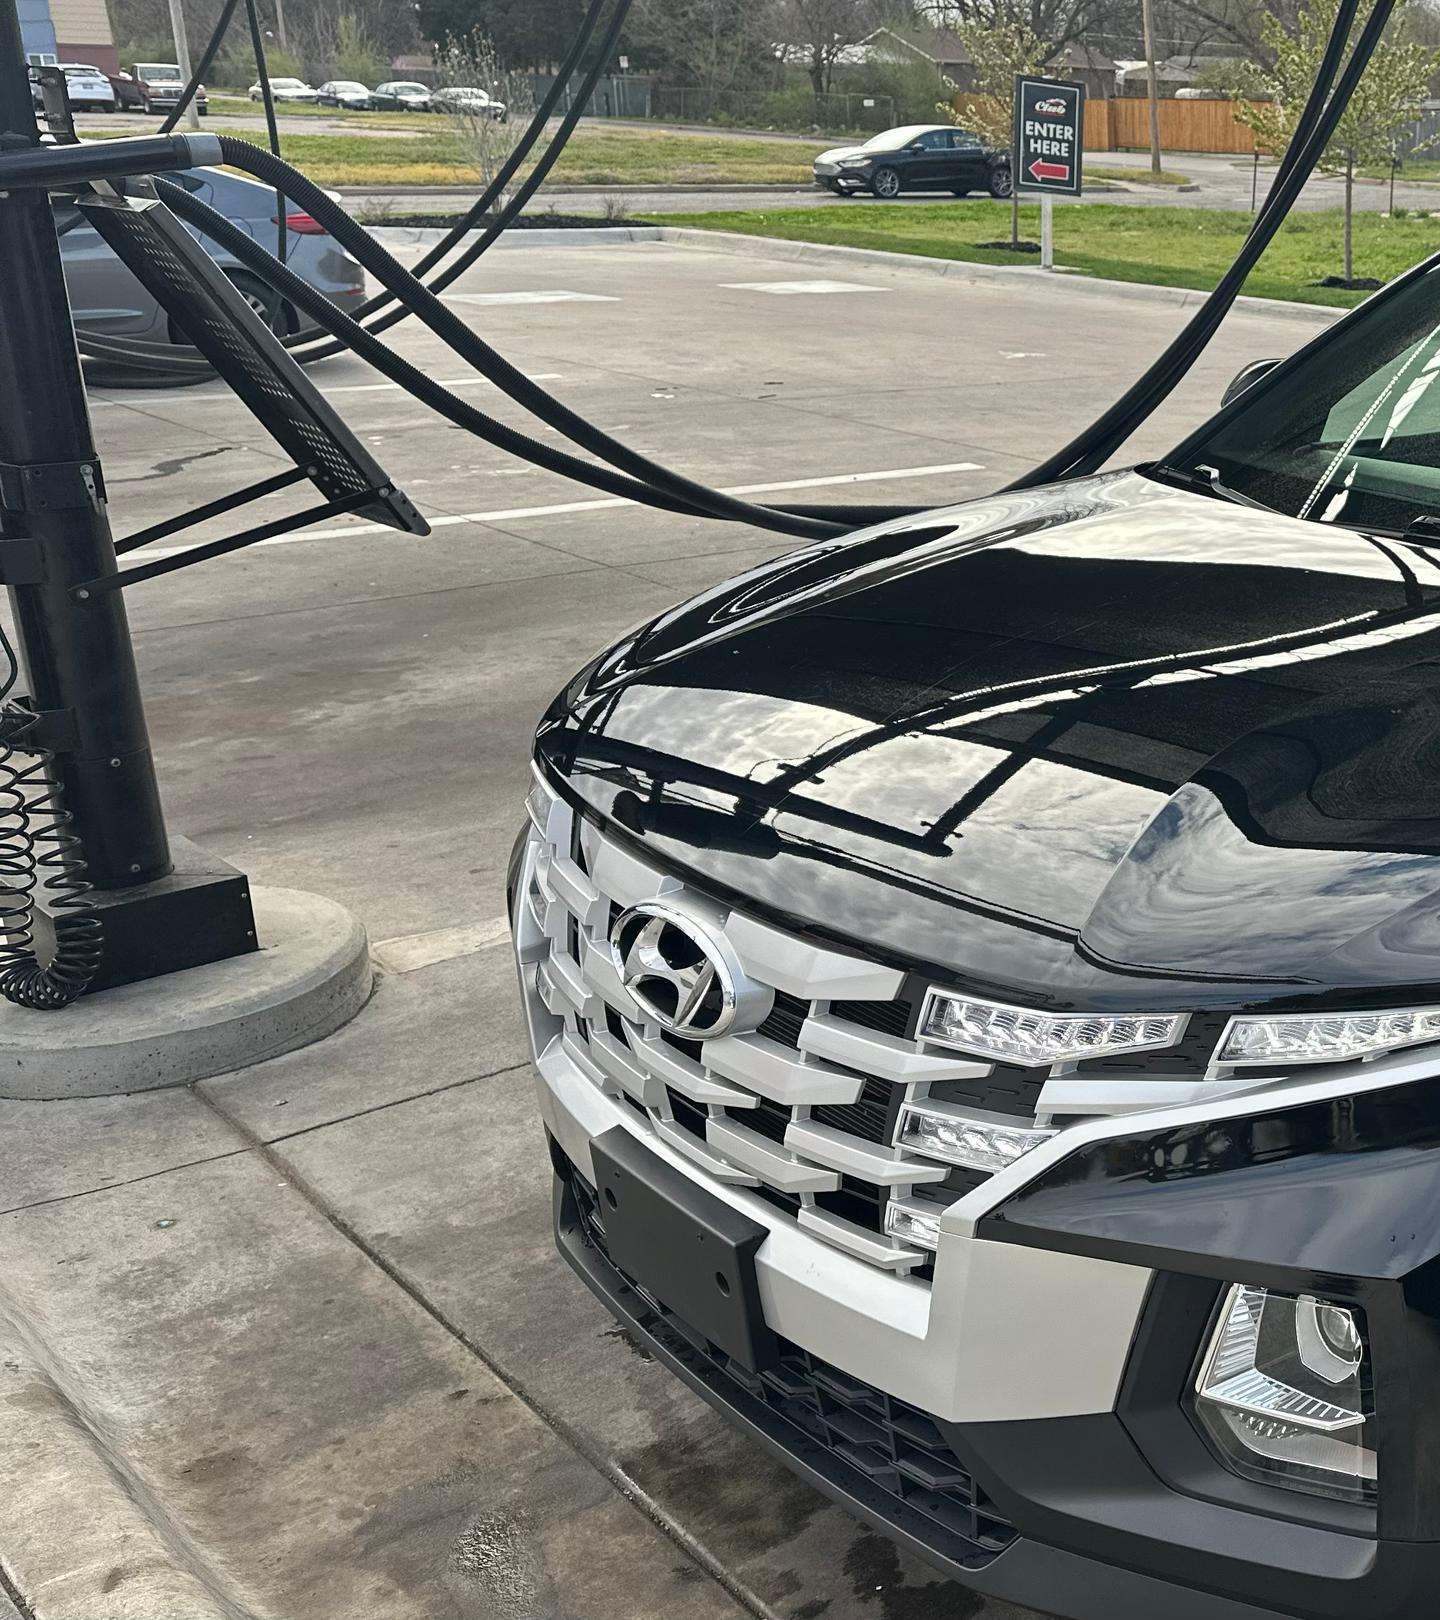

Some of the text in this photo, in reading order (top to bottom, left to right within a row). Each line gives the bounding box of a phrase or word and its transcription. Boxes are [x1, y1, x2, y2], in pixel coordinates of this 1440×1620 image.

[1035, 100, 1066, 114] Club
[1025, 120, 1074, 141] ENTER
[1029, 138, 1069, 157] HERE
